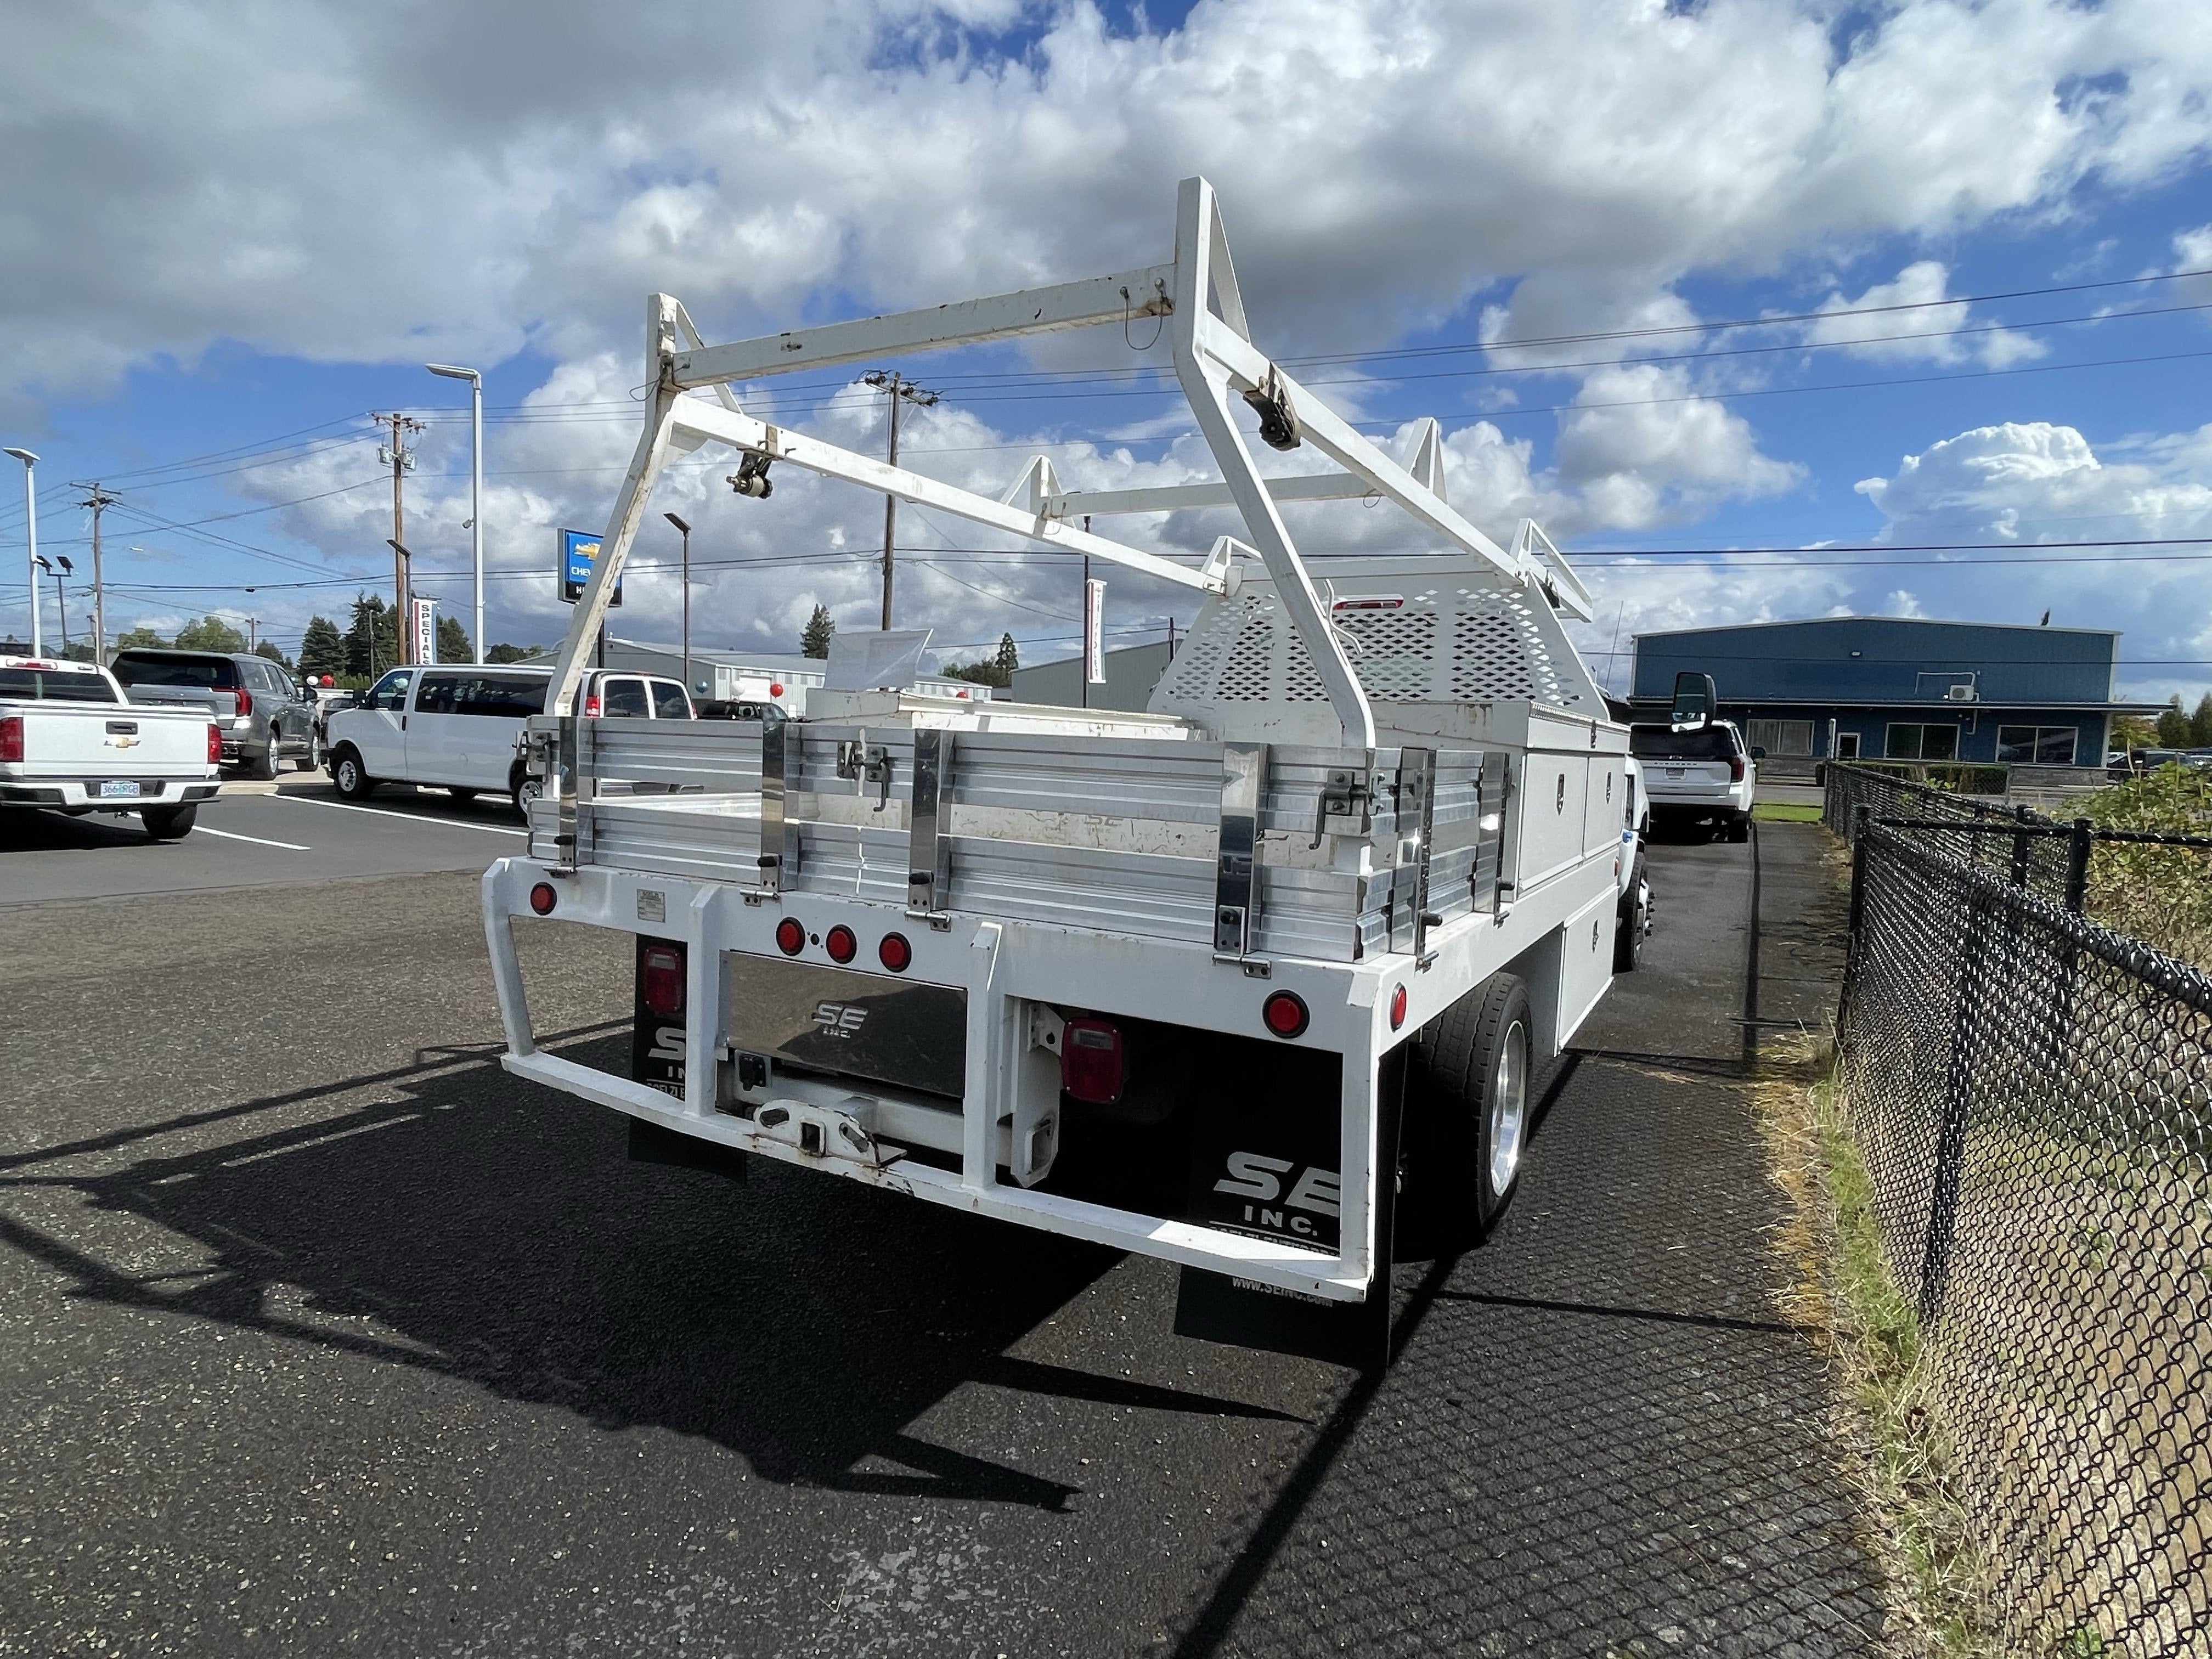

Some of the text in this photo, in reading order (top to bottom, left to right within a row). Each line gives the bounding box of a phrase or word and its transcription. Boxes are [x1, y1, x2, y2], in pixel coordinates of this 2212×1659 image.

[813, 1003, 867, 1029] SE
[1213, 1151, 1341, 1218] SE
[1244, 1205, 1318, 1236] INC.
